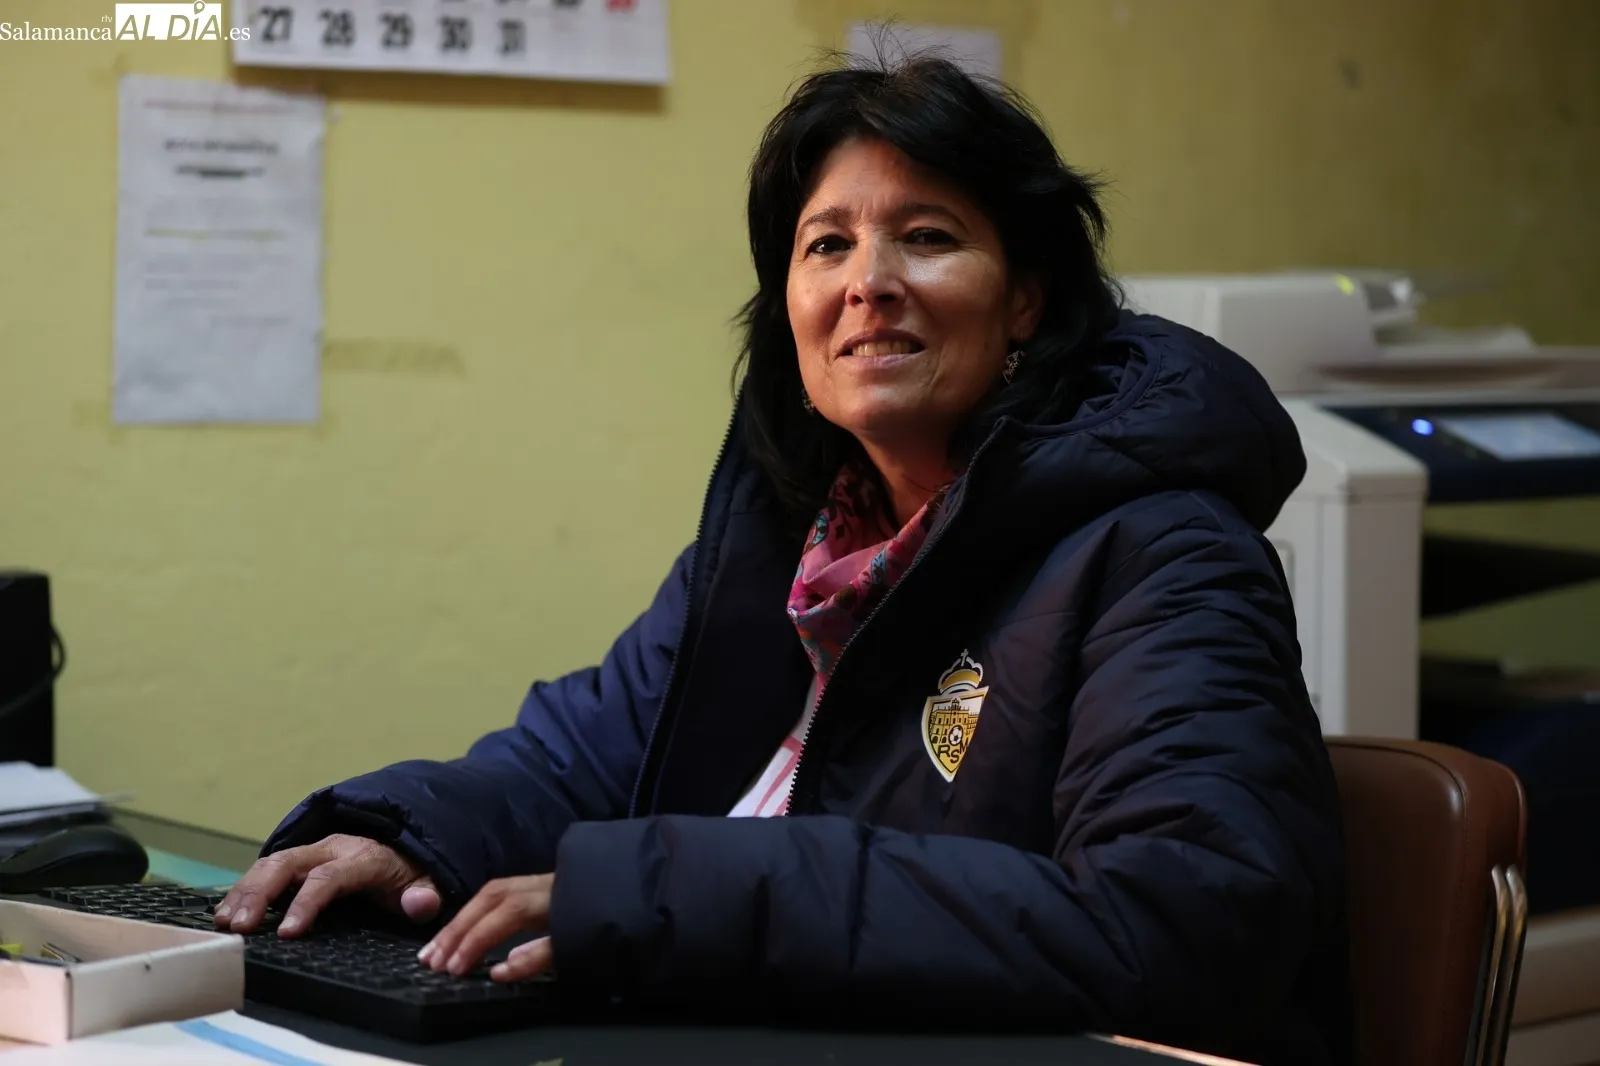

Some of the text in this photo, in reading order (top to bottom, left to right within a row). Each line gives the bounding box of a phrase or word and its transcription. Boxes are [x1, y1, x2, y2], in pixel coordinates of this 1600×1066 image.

[260, 7, 526, 54] 27 28 29 30 31
